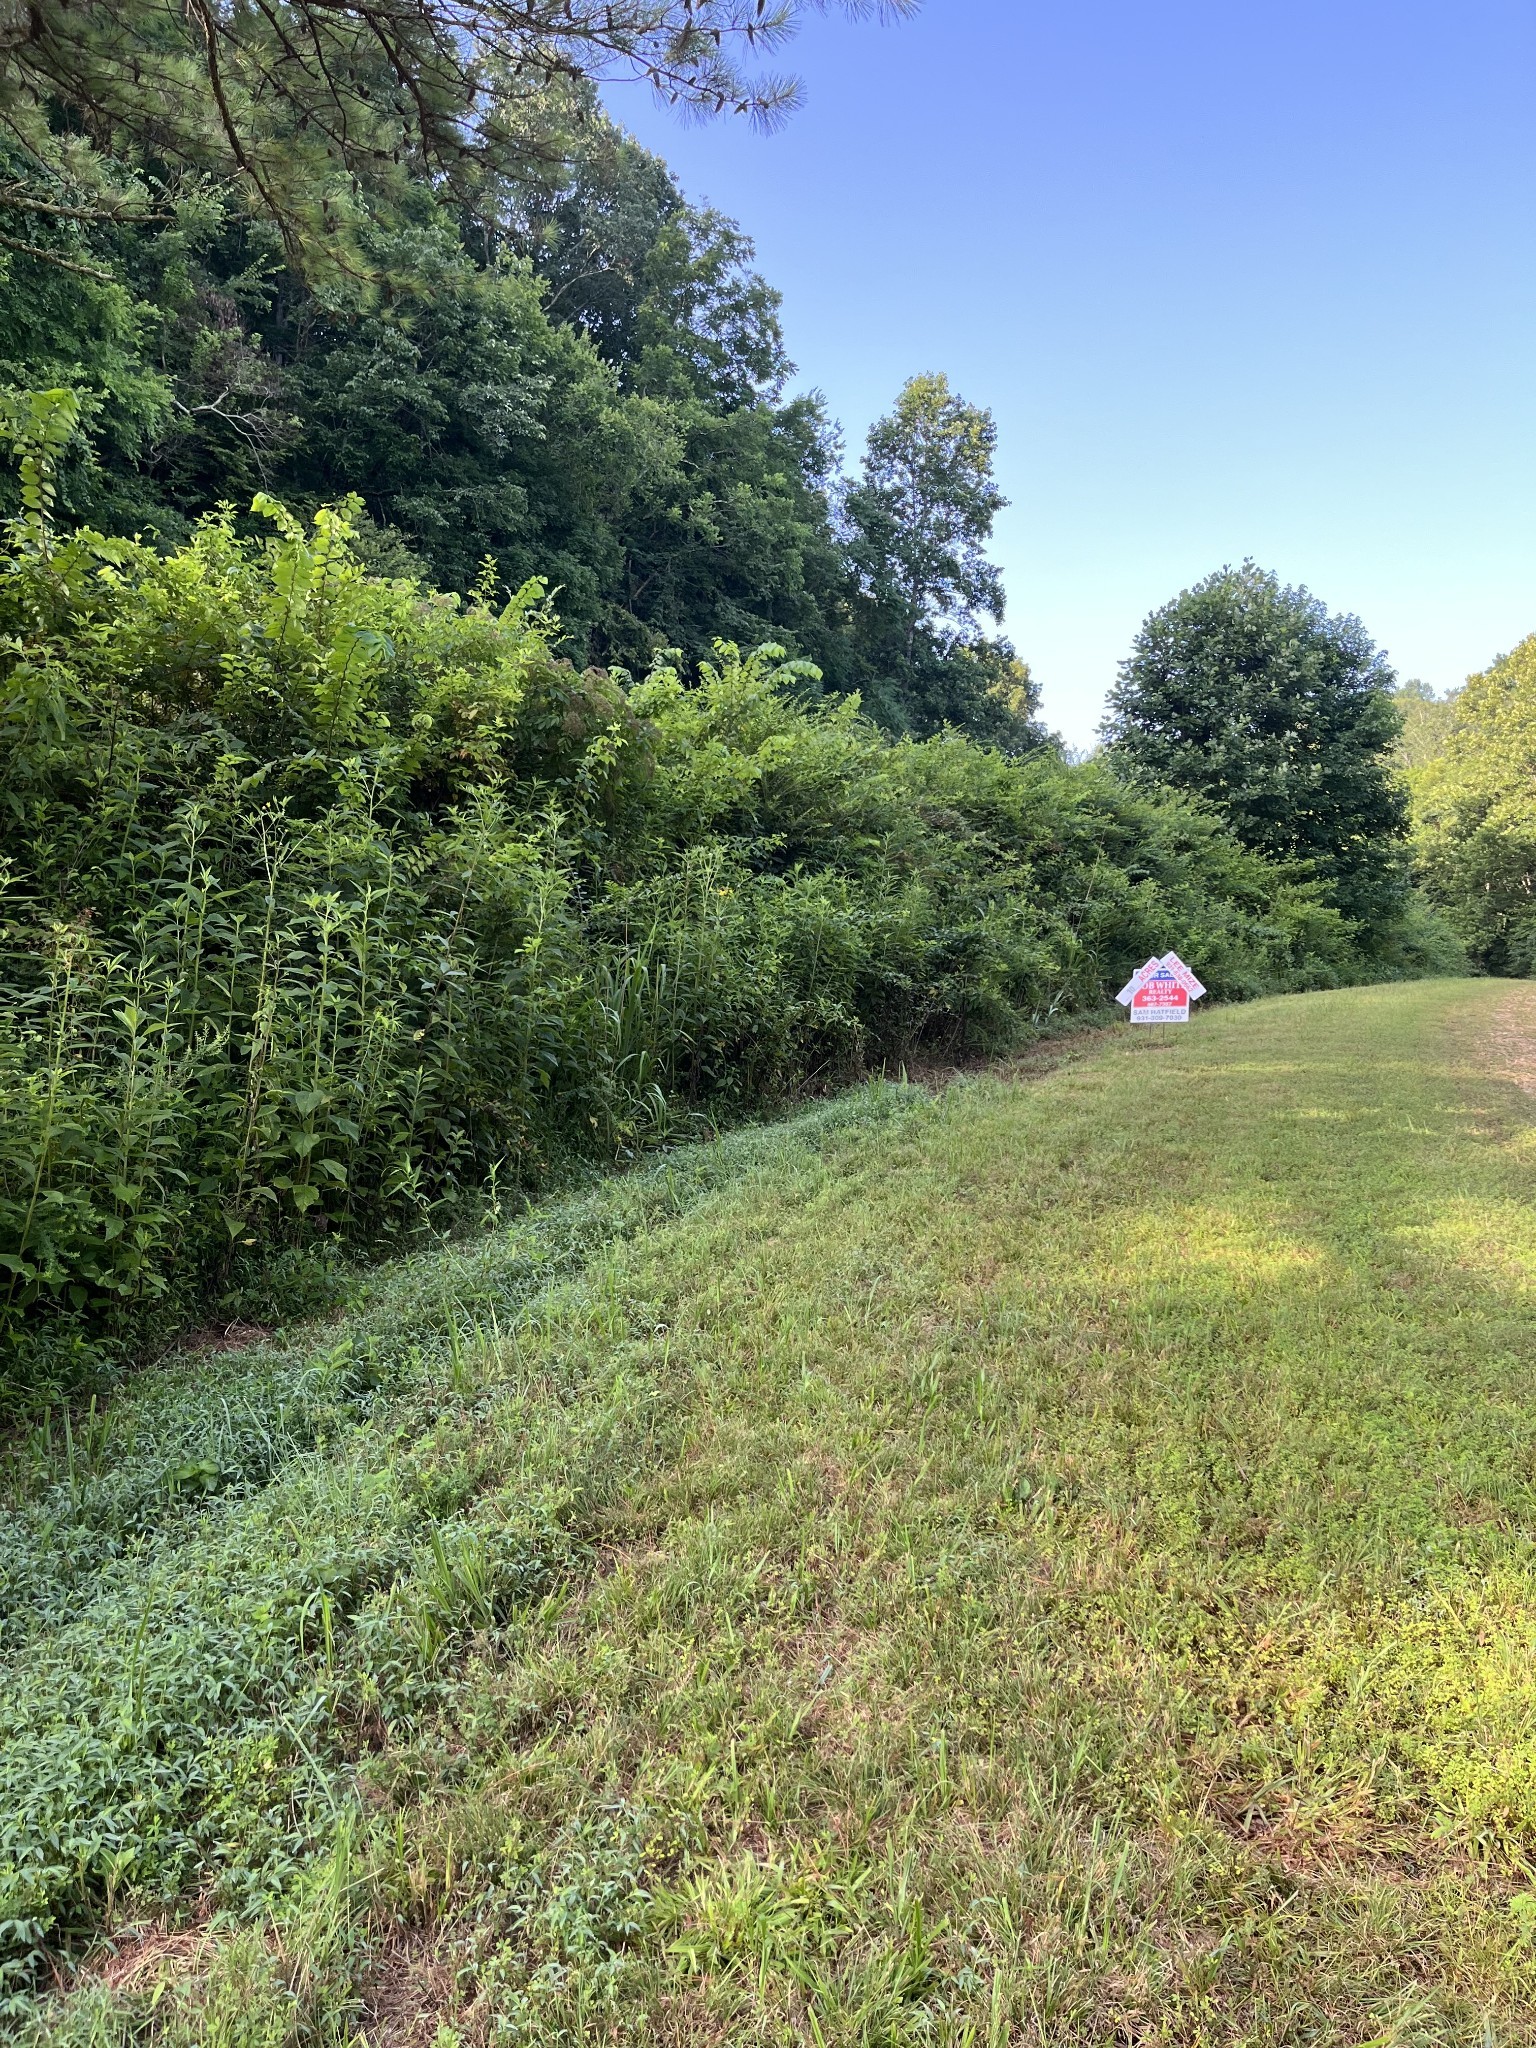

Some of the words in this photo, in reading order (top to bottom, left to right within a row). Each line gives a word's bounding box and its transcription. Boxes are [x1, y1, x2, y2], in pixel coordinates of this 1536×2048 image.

[1138, 960, 1160, 982] ACRES
[1169, 956, 1184, 973] LEE
[1183, 971, 1200, 990] MIZE
[1142, 981, 1154, 989] OB
